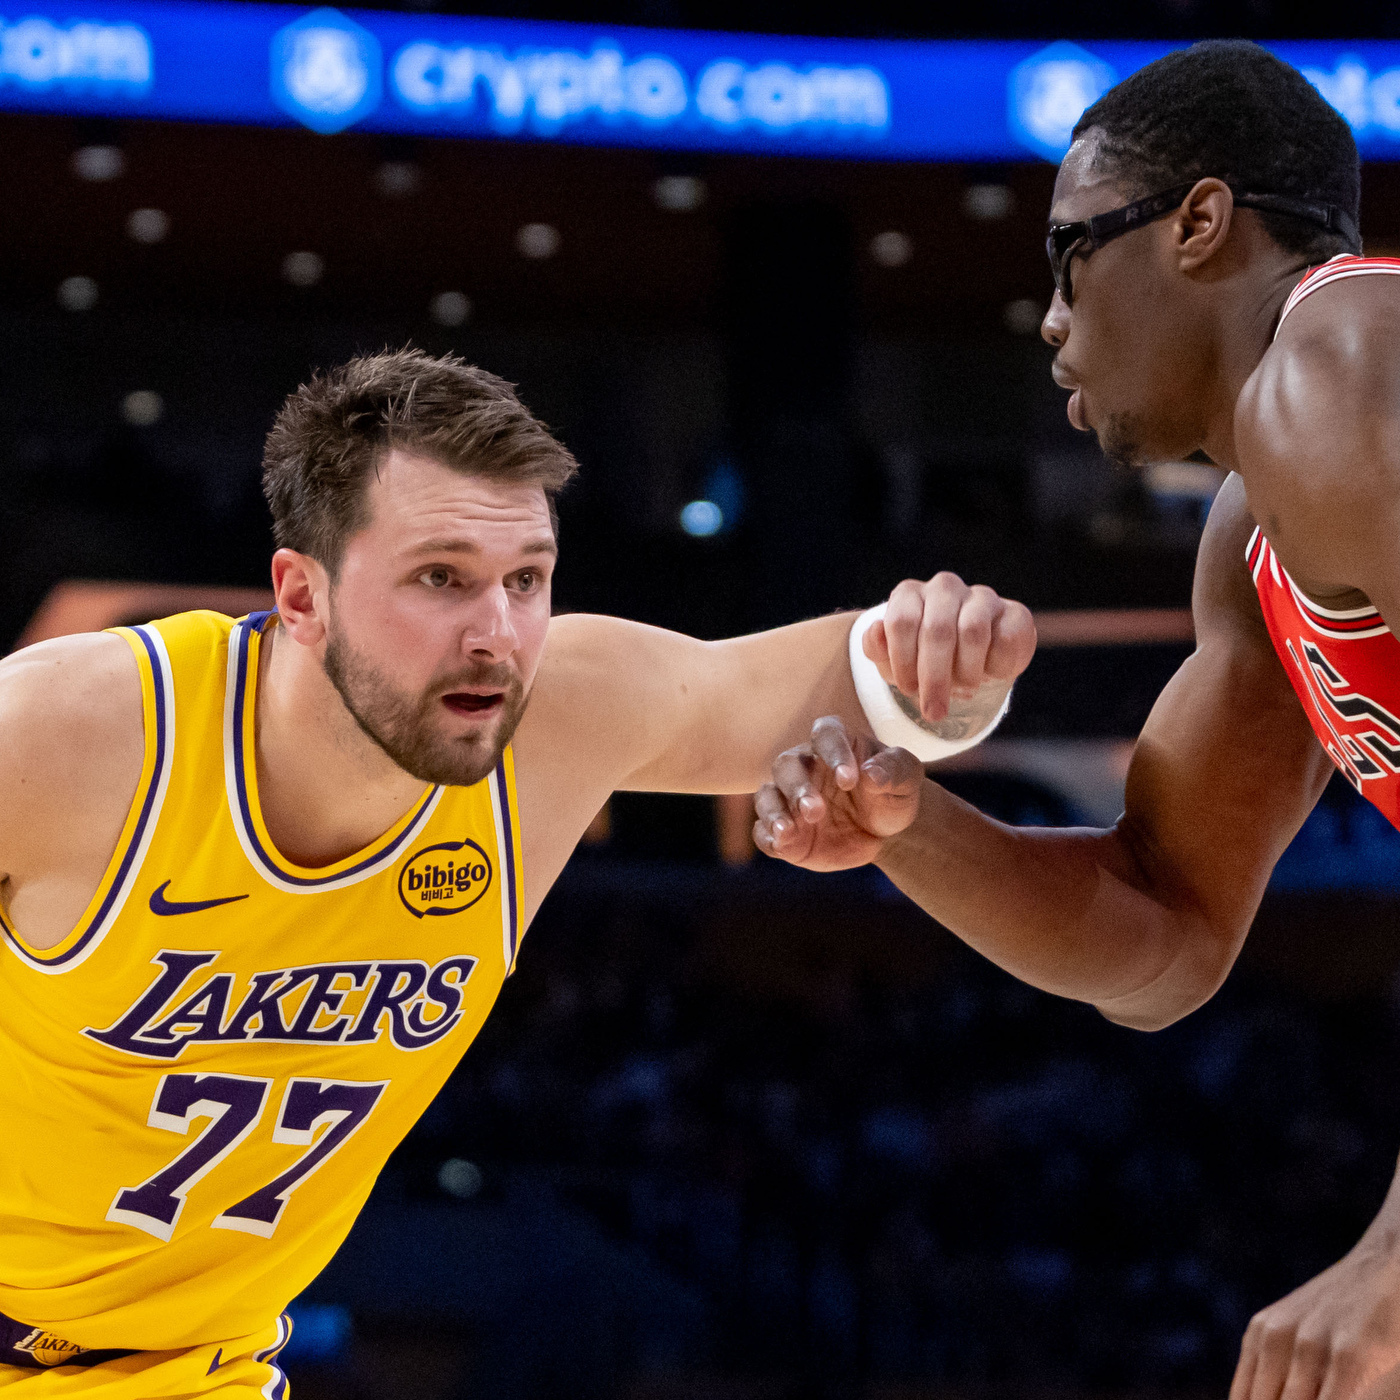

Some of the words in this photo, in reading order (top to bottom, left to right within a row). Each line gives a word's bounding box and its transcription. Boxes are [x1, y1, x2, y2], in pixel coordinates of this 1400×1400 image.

[392, 41, 889, 135] crypto.com
[408, 861, 486, 892] bibigo
[421, 887, 454, 902] 비비고
[81, 949, 479, 1060] LAKERS
[106, 1072, 391, 1243] 77
